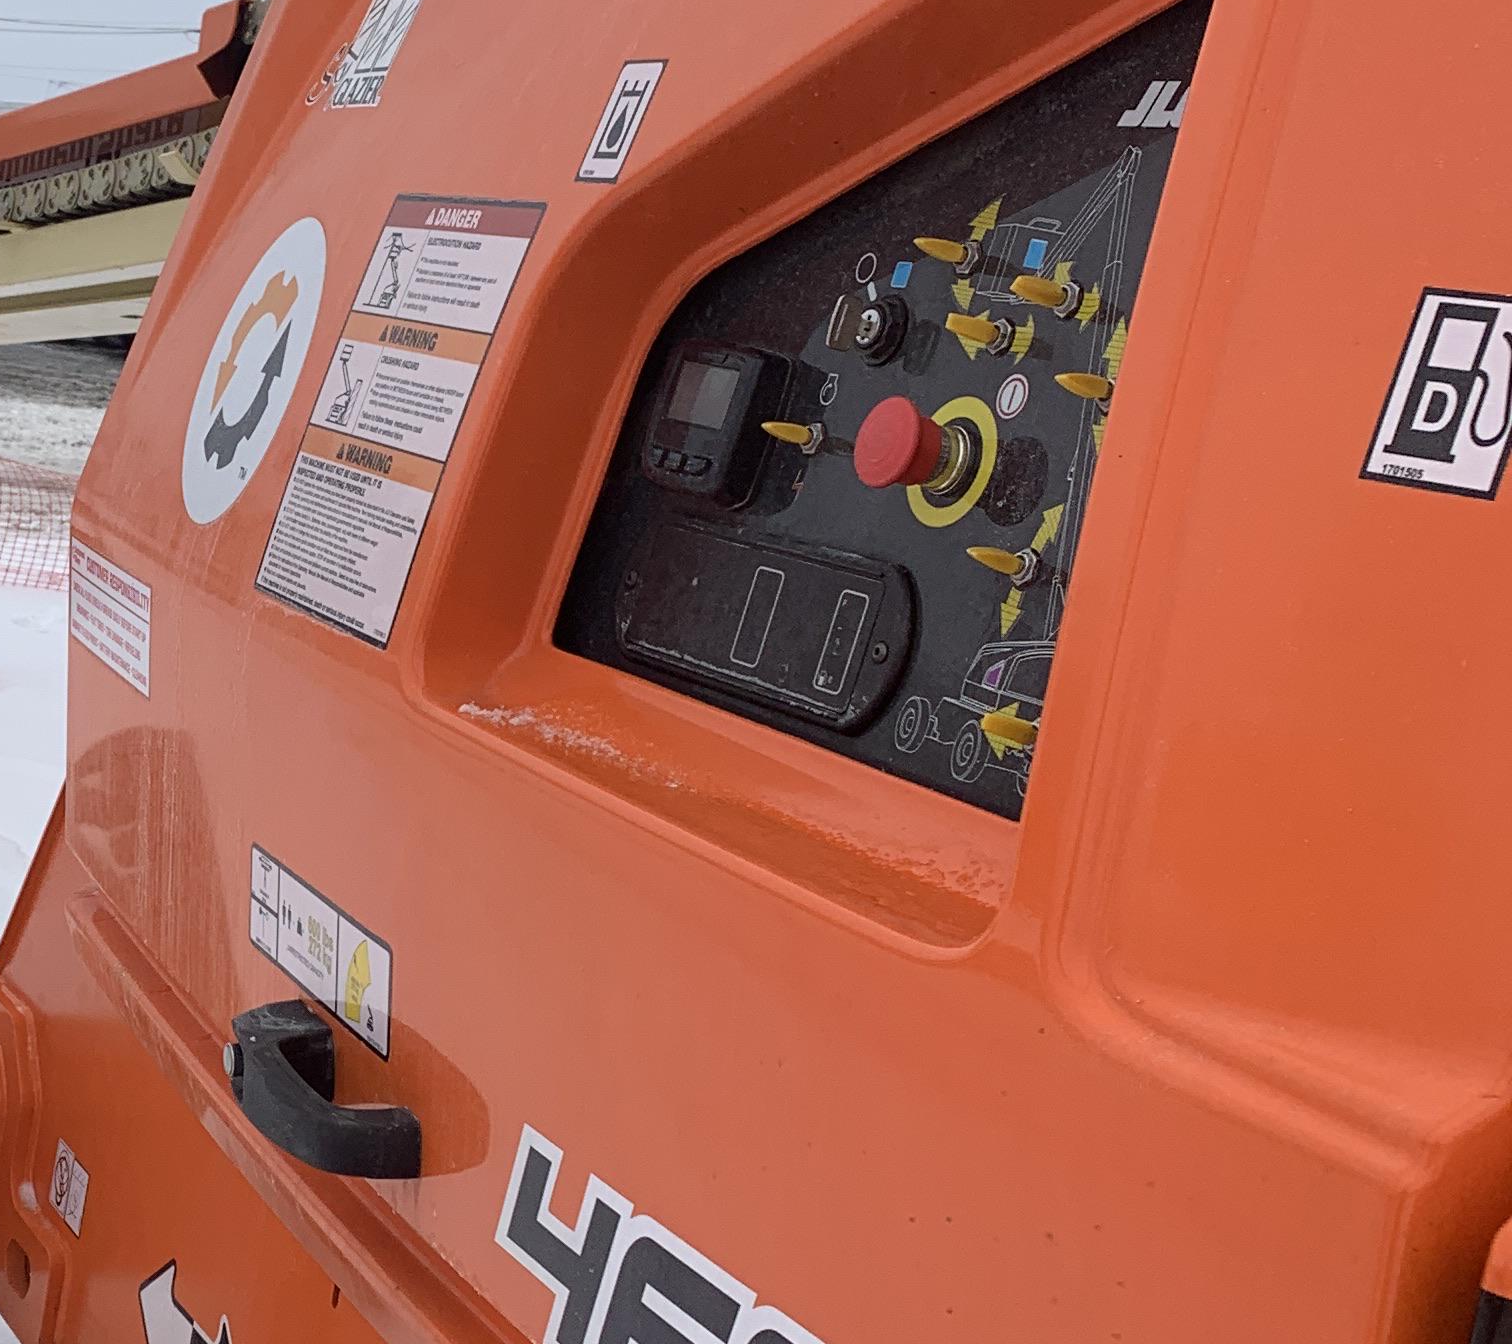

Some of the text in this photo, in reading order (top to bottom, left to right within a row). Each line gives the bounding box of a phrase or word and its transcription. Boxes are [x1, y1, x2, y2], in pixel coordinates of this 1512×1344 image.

[332, 75, 386, 106] GLAZIER
[434, 208, 483, 229] DANGER
[388, 325, 438, 351] WARNING
[1411, 381, 1458, 432] D
[345, 444, 393, 474] WARNING
